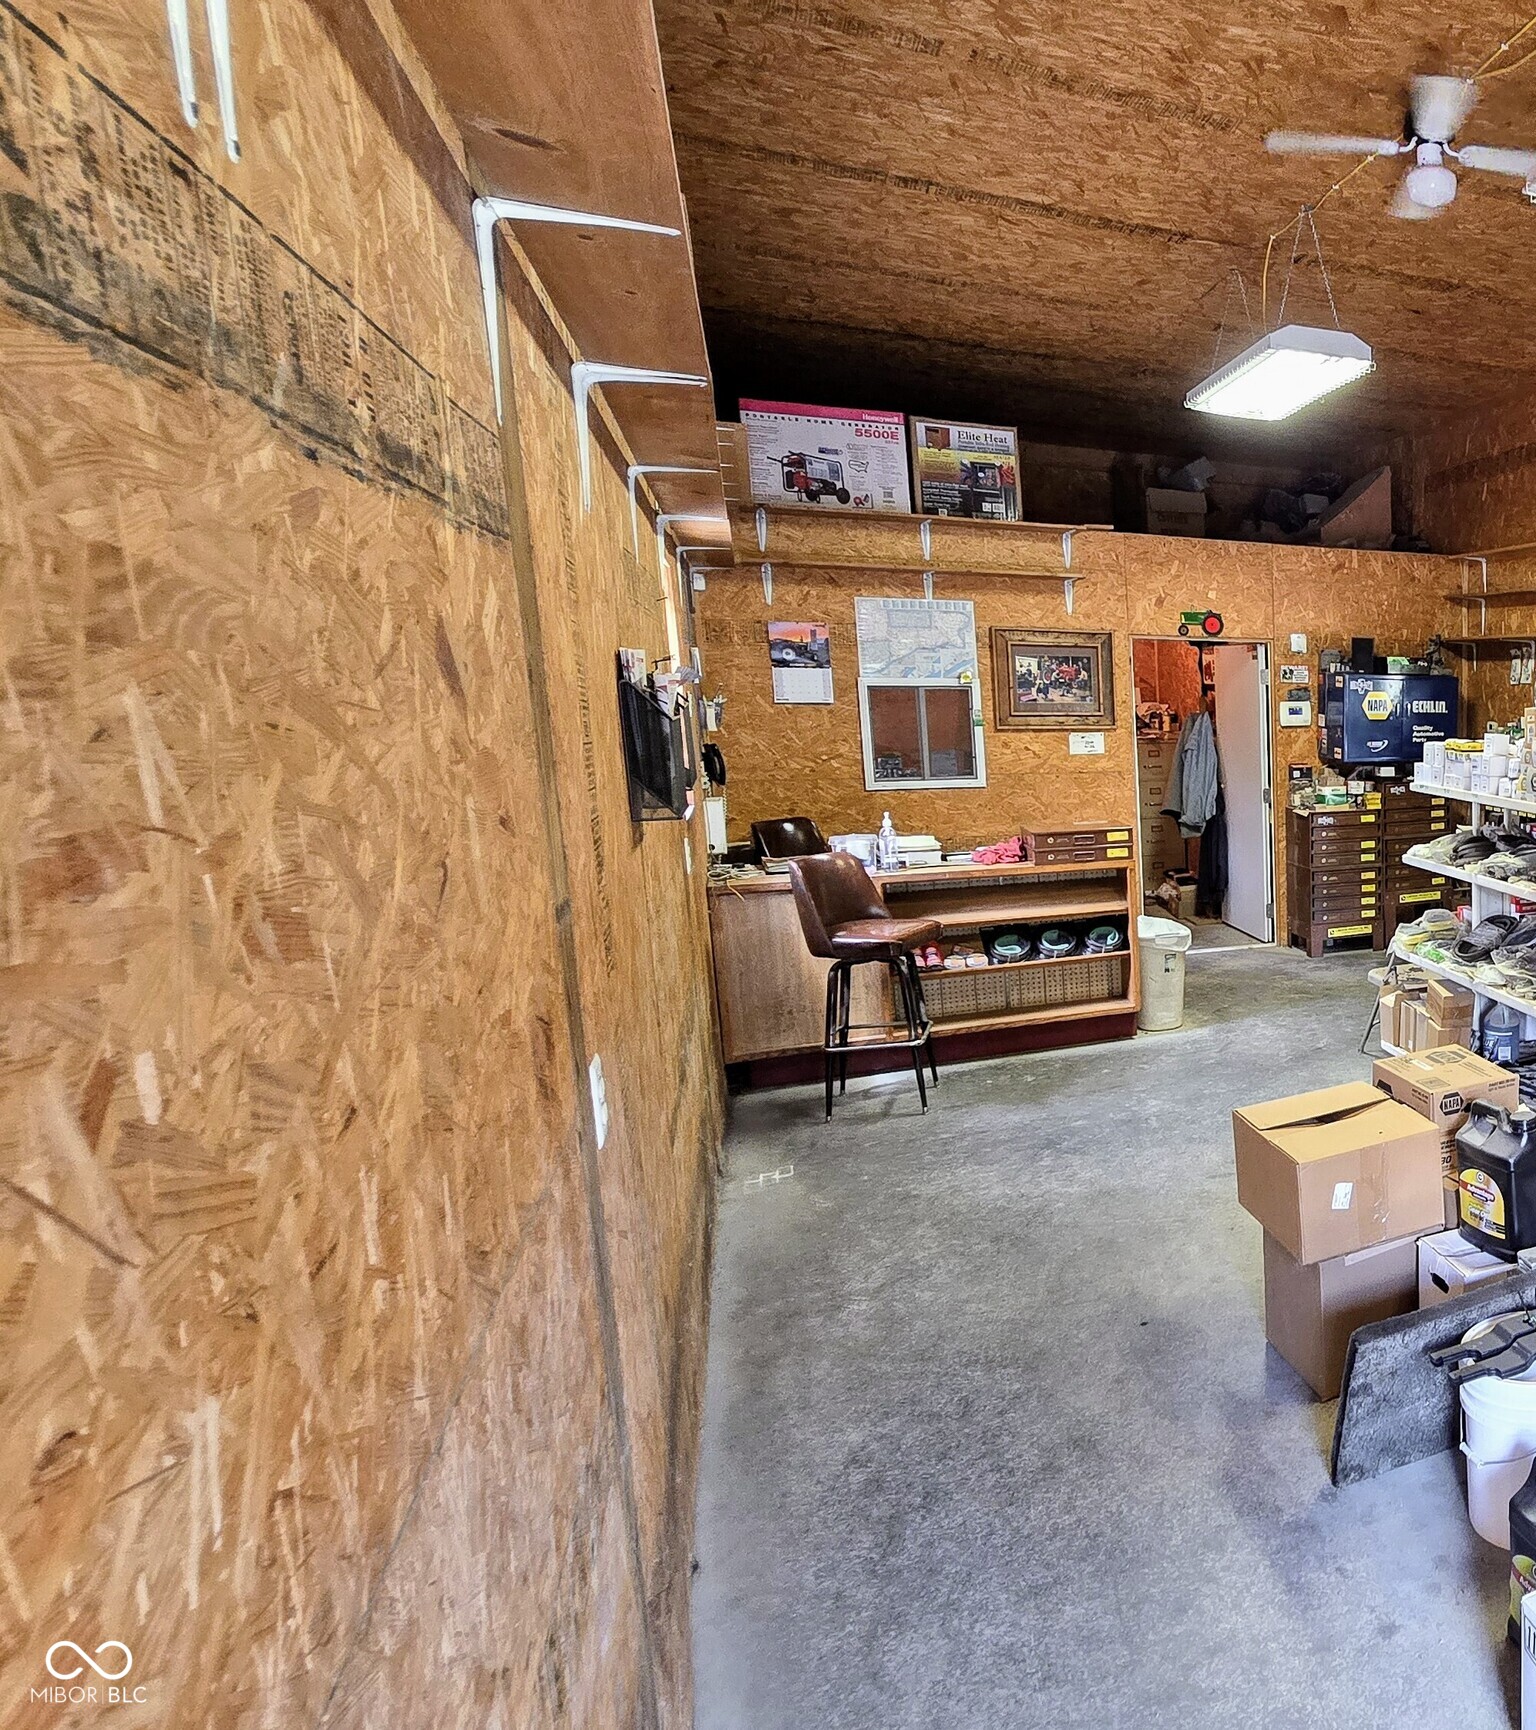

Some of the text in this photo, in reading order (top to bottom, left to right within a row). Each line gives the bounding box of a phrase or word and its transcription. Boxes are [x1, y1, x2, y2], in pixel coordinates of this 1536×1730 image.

[862, 413, 899, 423] Honeywell
[854, 427, 899, 441] 5500E
[957, 430, 1007, 444] Elite Heat
[1367, 701, 1388, 712] NAPA
[1443, 1098, 1460, 1111] NAPA
